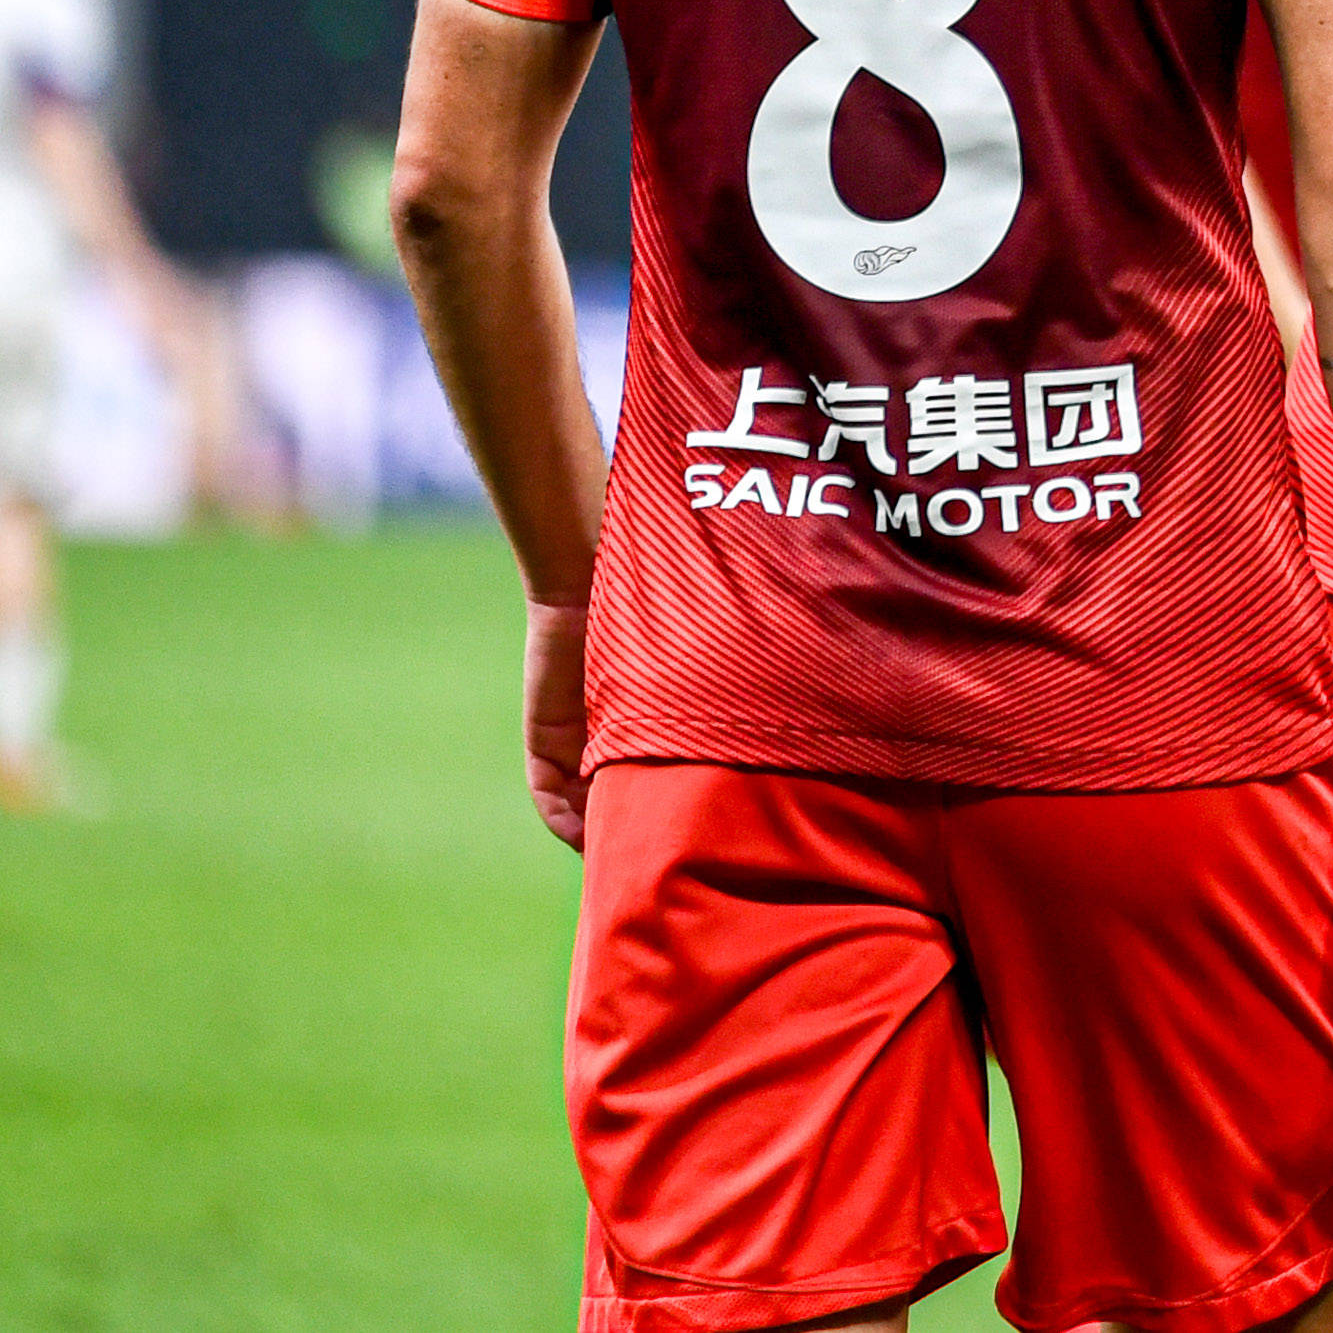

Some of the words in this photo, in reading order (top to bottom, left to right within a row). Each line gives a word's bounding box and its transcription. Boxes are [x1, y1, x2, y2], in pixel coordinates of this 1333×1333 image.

[685, 363, 1143, 476] 上汽集团
[684, 464, 856, 519] SAIC
[873, 472, 1143, 538] MOTOR
